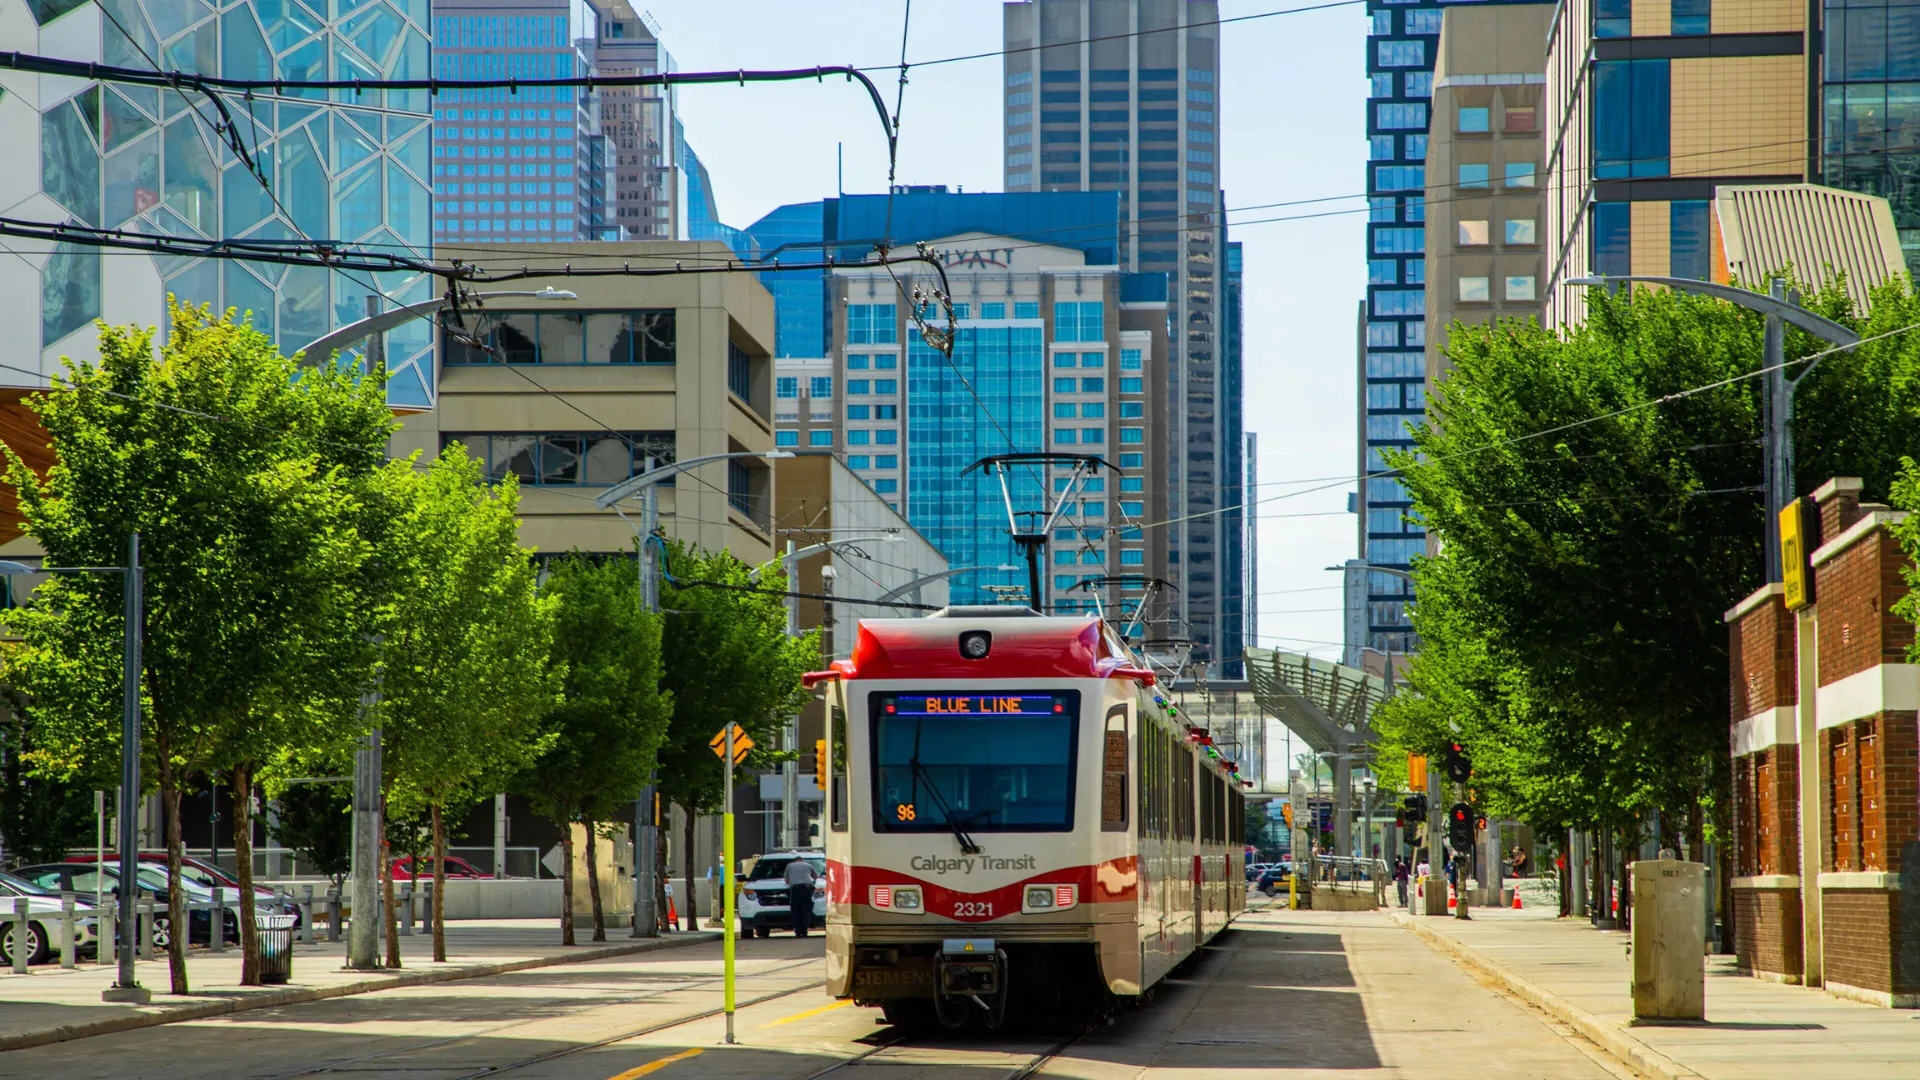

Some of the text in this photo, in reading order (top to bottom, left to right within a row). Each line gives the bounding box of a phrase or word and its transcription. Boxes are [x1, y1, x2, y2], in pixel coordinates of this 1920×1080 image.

[925, 697, 1023, 713] BLUE LINE
[897, 804, 916, 821] 96
[910, 854, 1036, 874] Calgary Transit
[953, 902, 993, 917] 2321
[855, 970, 934, 986] SIEMENS
